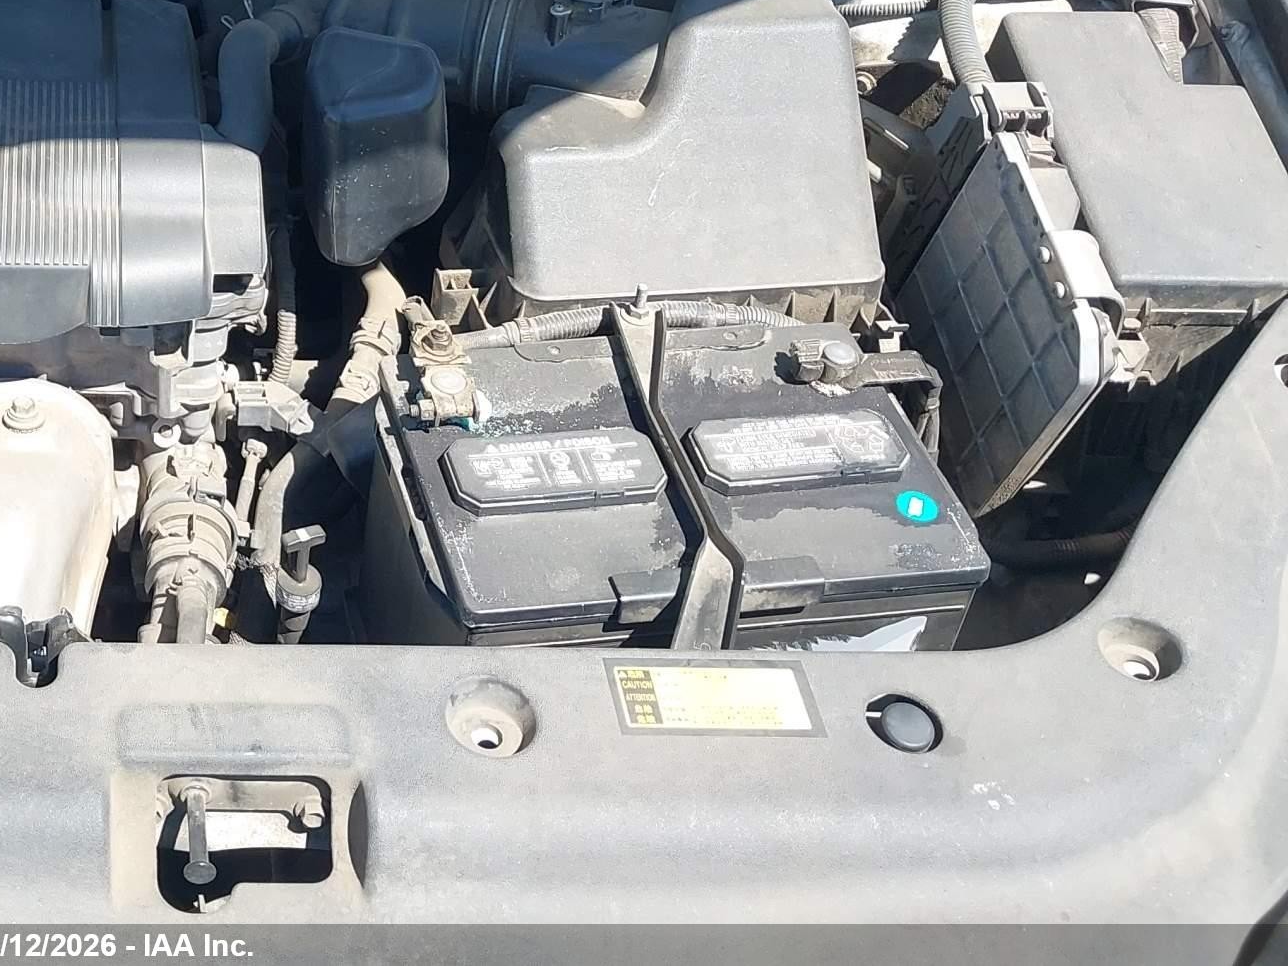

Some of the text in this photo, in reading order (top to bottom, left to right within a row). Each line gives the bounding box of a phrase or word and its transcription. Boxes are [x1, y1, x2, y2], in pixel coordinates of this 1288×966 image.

[498, 439, 553, 453] DANGER
[562, 435, 612, 447] POISON
[622, 680, 653, 690] CAUTION
[625, 693, 657, 702] ATTENTION
